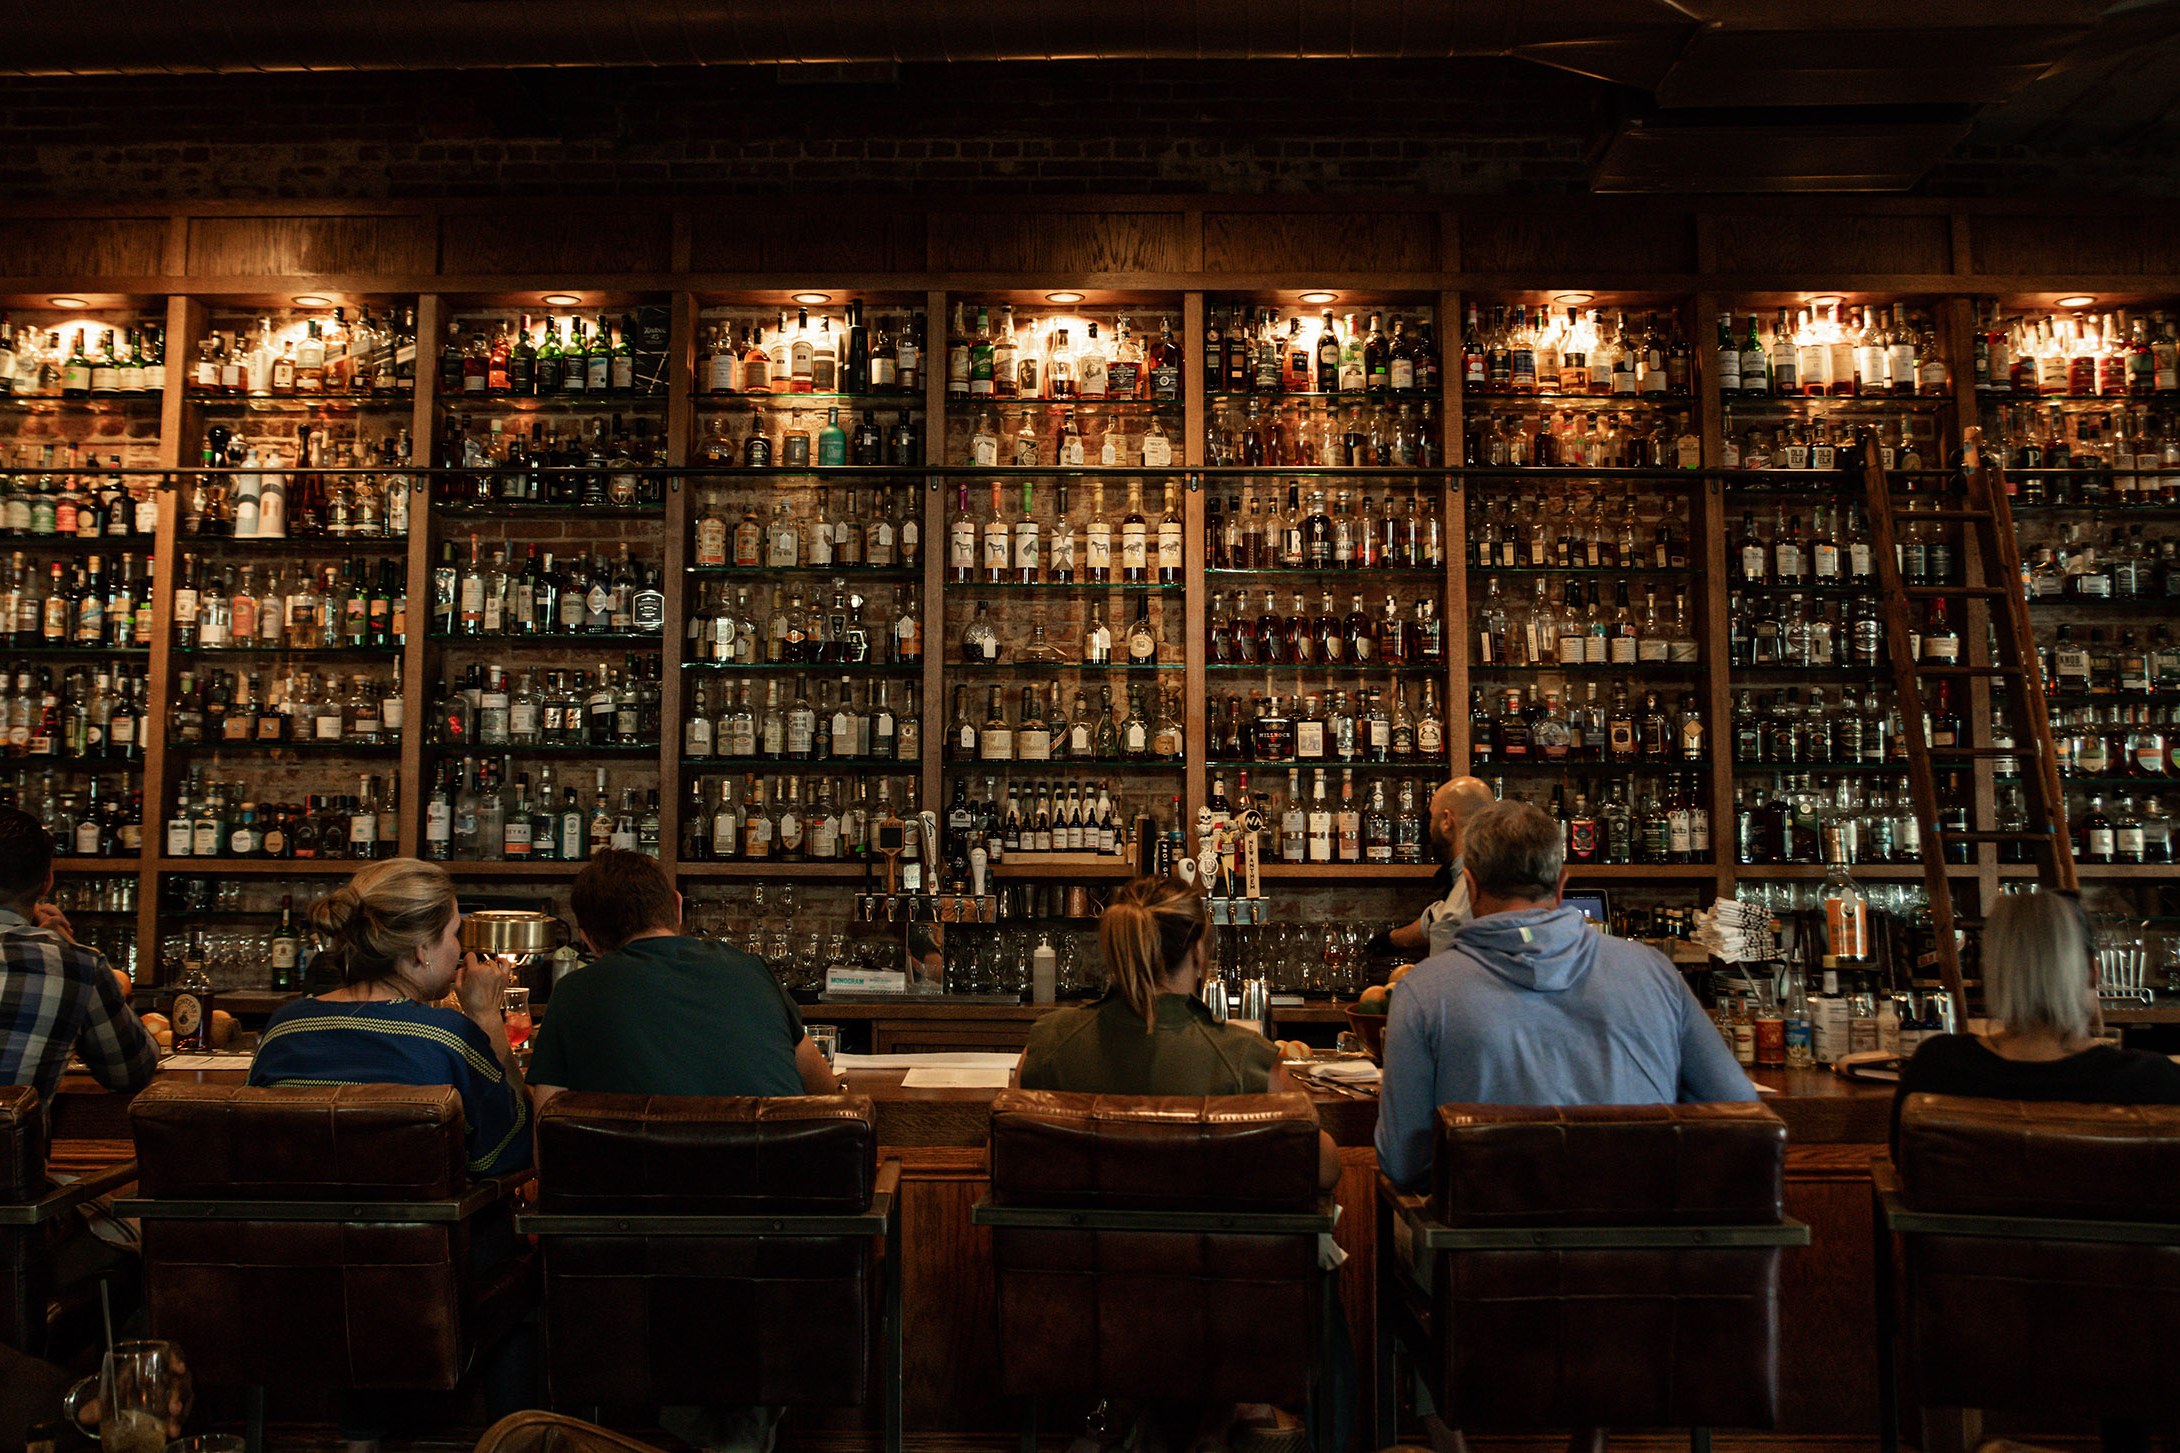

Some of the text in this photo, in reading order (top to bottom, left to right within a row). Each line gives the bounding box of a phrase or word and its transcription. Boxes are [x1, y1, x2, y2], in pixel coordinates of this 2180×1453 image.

[1416, 367, 1428, 376] 105
[1790, 449, 1804, 457] OLD
[1818, 449, 1832, 457] OLD
[1790, 456, 1804, 464] ELK
[1818, 456, 1832, 464] ELK
[2059, 655, 2081, 664] KNOB
[830, 976, 865, 985] MONOGRAM
